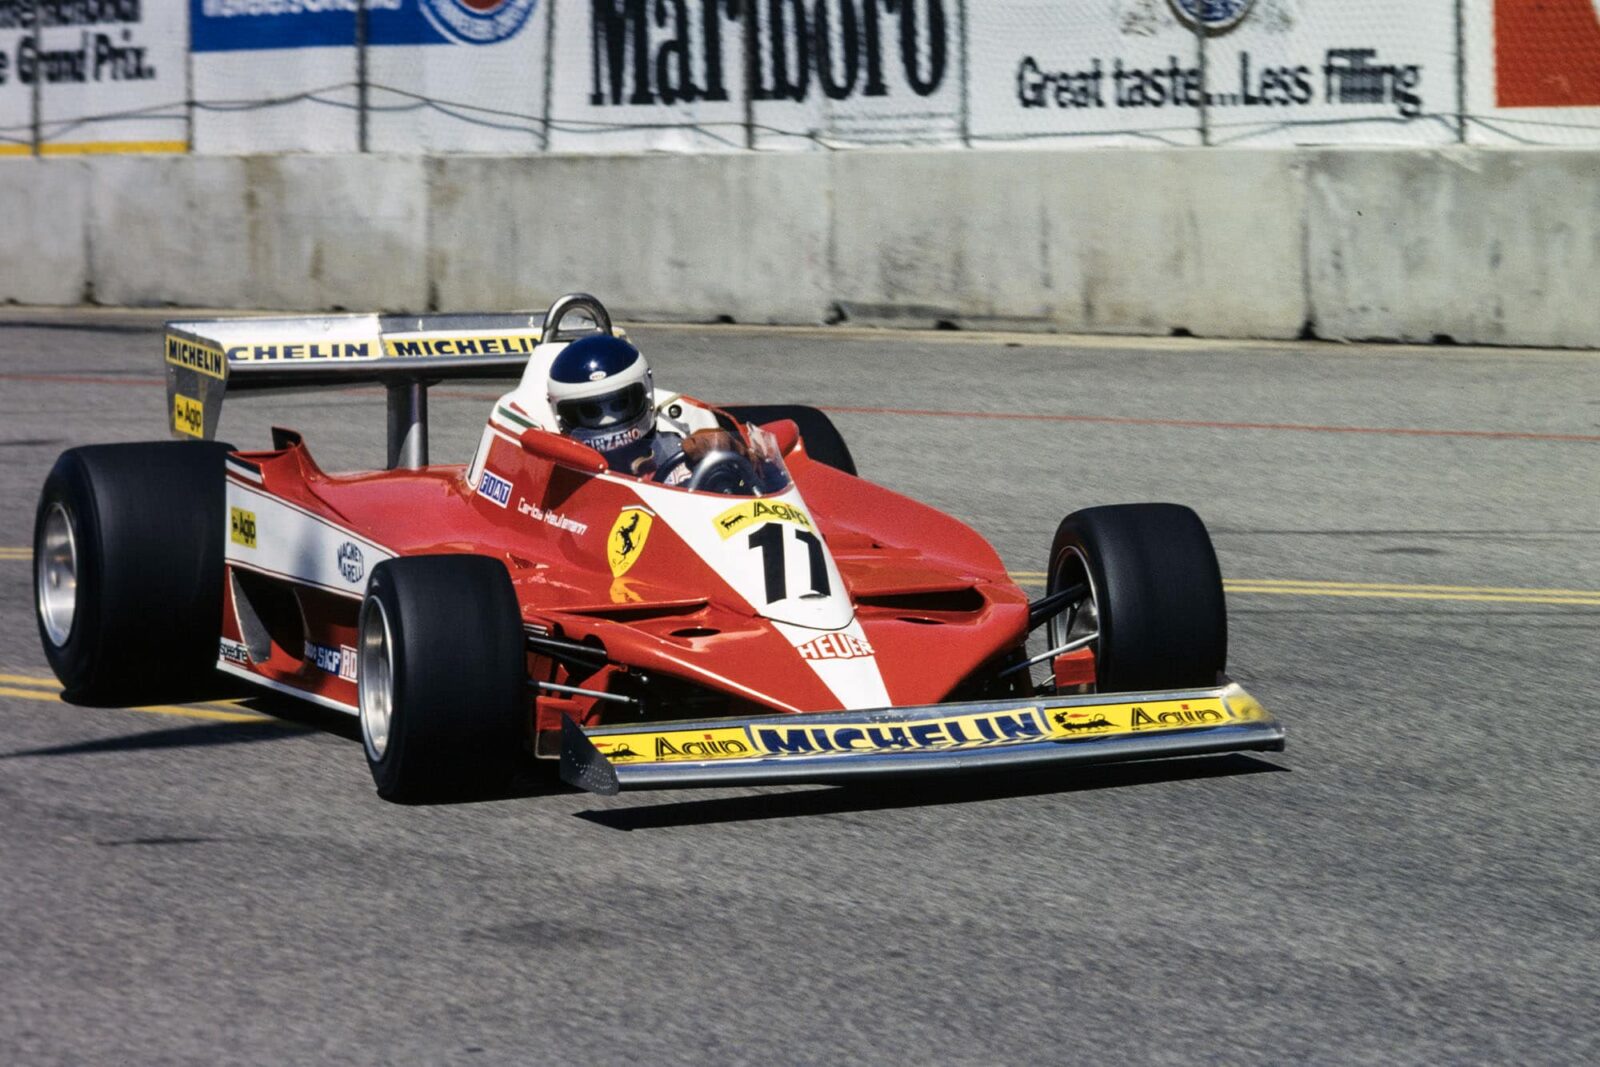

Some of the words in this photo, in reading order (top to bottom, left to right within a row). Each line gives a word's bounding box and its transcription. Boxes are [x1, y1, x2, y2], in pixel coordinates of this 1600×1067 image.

[17, 30, 88, 83] Grand
[1018, 56, 1104, 108] Great
[168, 338, 222, 374] MICHELIN
[185, 400, 202, 432] Agip
[480, 475, 511, 504] FIAT
[239, 511, 257, 545] Agip
[752, 501, 810, 526] Agip
[748, 522, 831, 605] 11
[317, 647, 340, 672] SKF
[797, 633, 875, 659] HEUER
[758, 711, 1042, 752] MICHELIN
